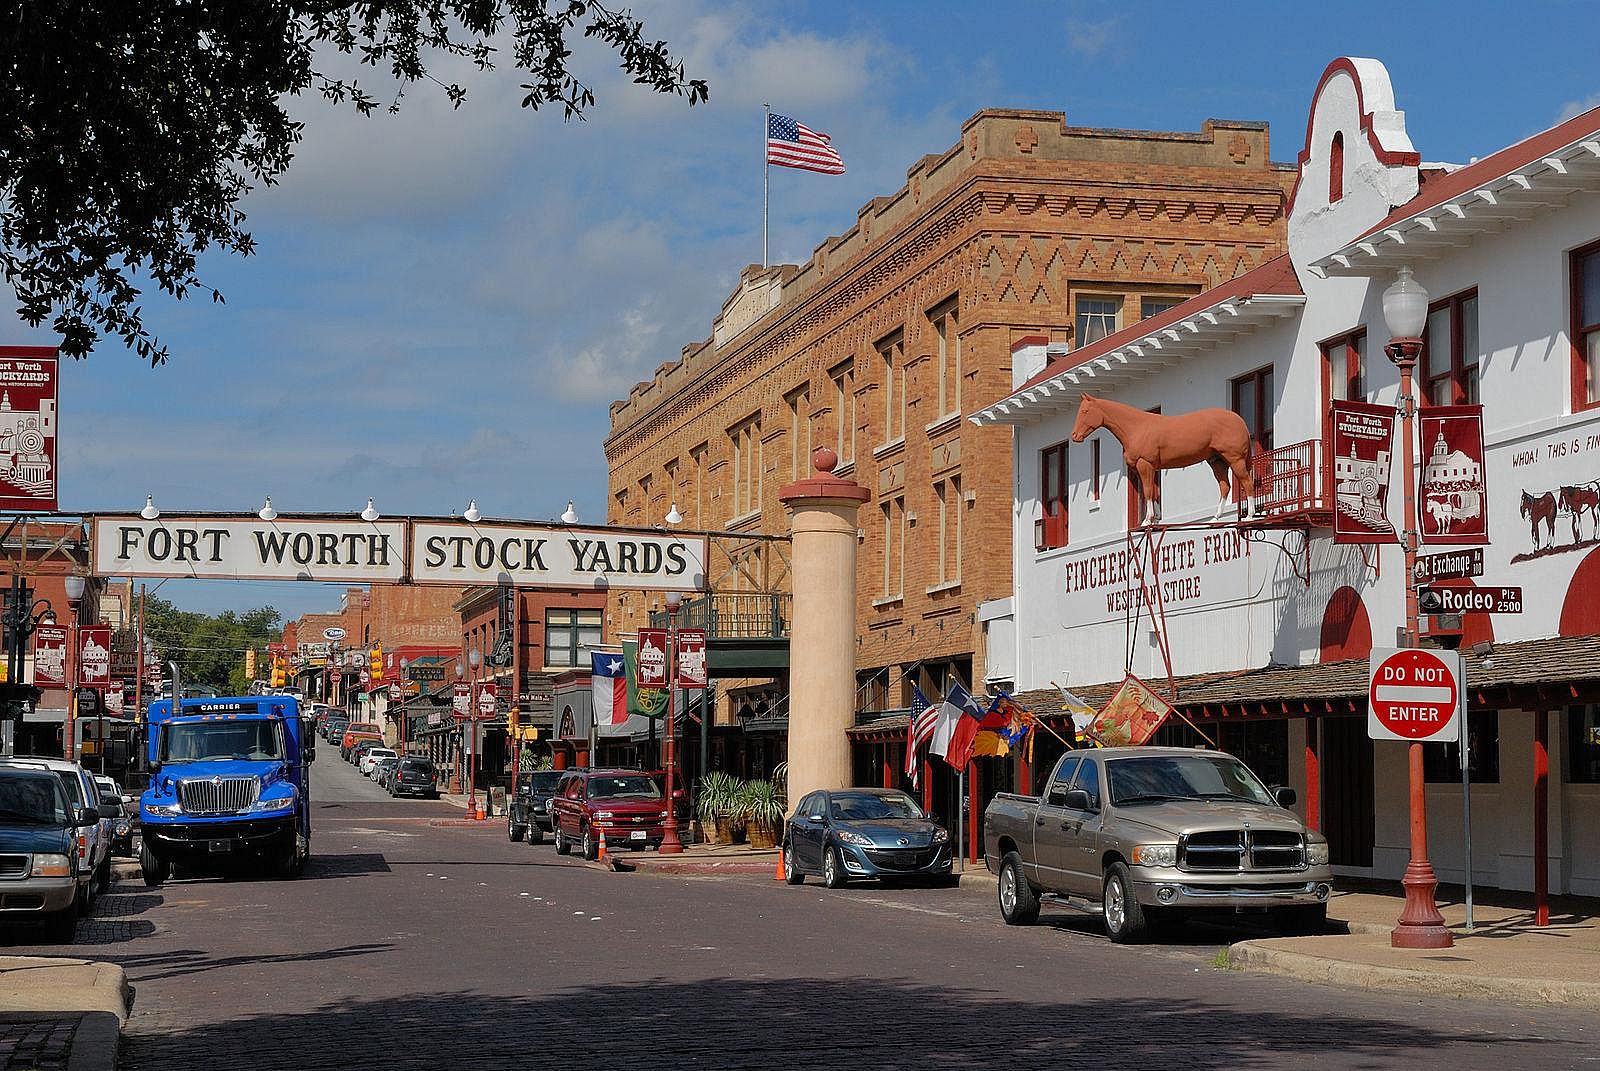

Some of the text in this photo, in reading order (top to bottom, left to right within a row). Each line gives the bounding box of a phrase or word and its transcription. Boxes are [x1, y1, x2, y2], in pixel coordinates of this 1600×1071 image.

[16, 362, 42, 371] Worth
[1338, 422, 1388, 437] STOCKYARDS
[1362, 416, 1383, 427] Worth
[1512, 447, 1539, 468] WHOA!
[1547, 442, 1567, 459] THIS
[1570, 438, 1580, 455] IS
[117, 526, 391, 566] FORT WORTH
[425, 535, 687, 575] STOCK YARDS
[1203, 530, 1252, 566] FRONT
[1425, 554, 1470, 578] E Exchange
[1163, 575, 1201, 604] STORE
[1501, 589, 1516, 600] Plz
[1442, 589, 1493, 610] Rodeo
[1497, 601, 1521, 612] 2500
[1384, 666, 1445, 682] DO NOT
[1389, 707, 1439, 722] ENTER
